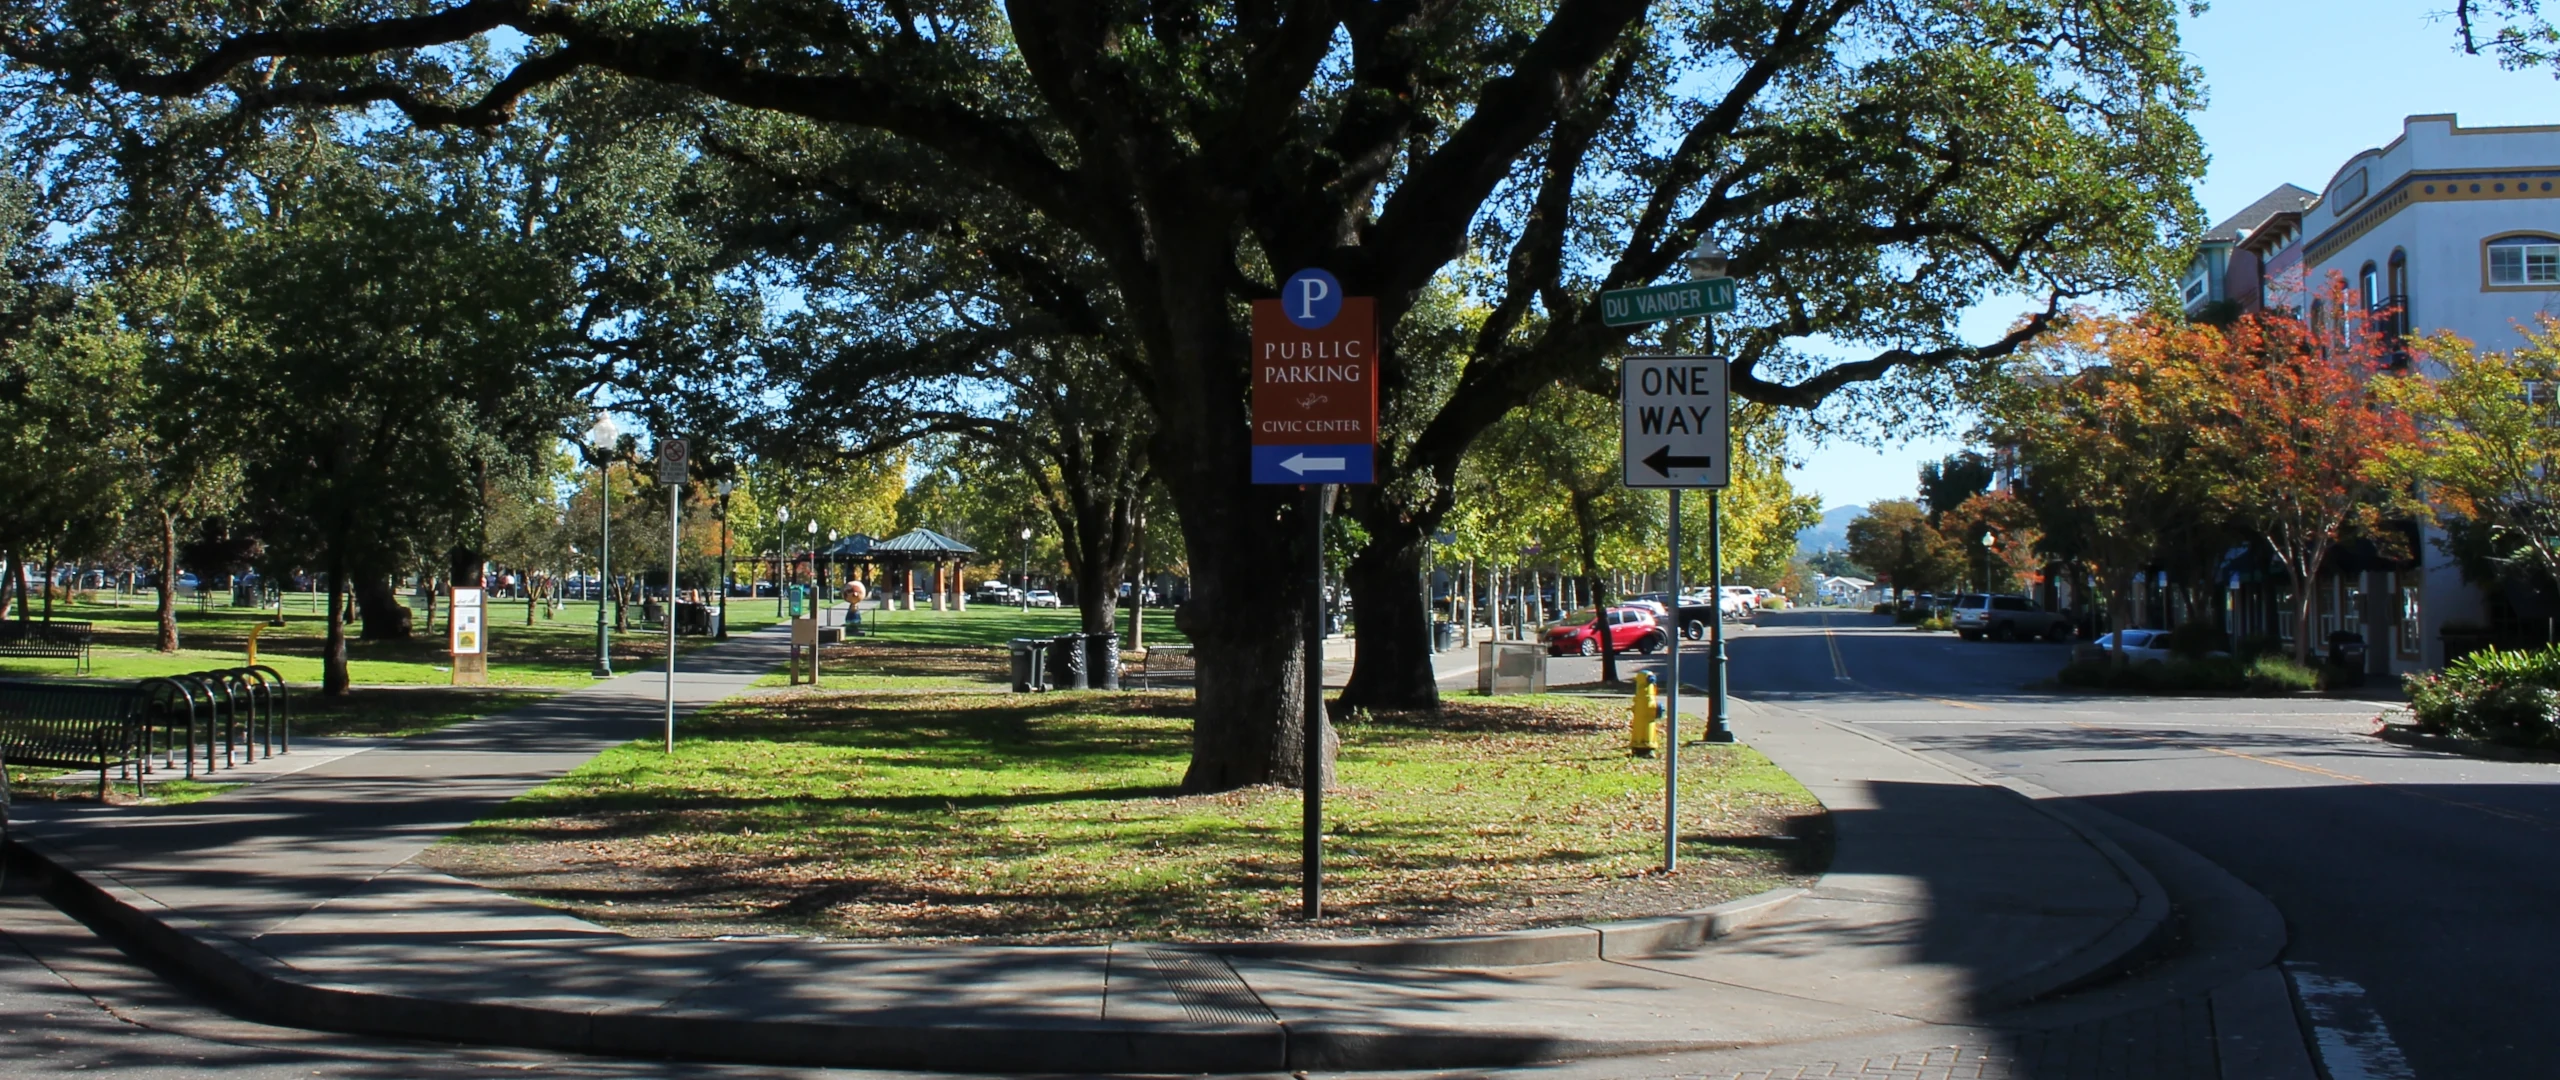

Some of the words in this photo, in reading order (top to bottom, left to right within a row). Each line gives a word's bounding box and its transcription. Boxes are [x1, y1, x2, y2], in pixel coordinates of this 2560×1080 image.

[1298, 278, 1328, 319] P
[1606, 297, 1629, 318] DU
[1636, 288, 1702, 314] VANDER
[1708, 284, 1732, 305] LN
[1265, 340, 1361, 360] PUBLIC
[1265, 364, 1361, 383] PARKING
[1641, 366, 1710, 396] ONE
[1262, 420, 1302, 433] CIVIC
[1305, 419, 1361, 432] CENTER
[1639, 405, 1712, 435] WAY
